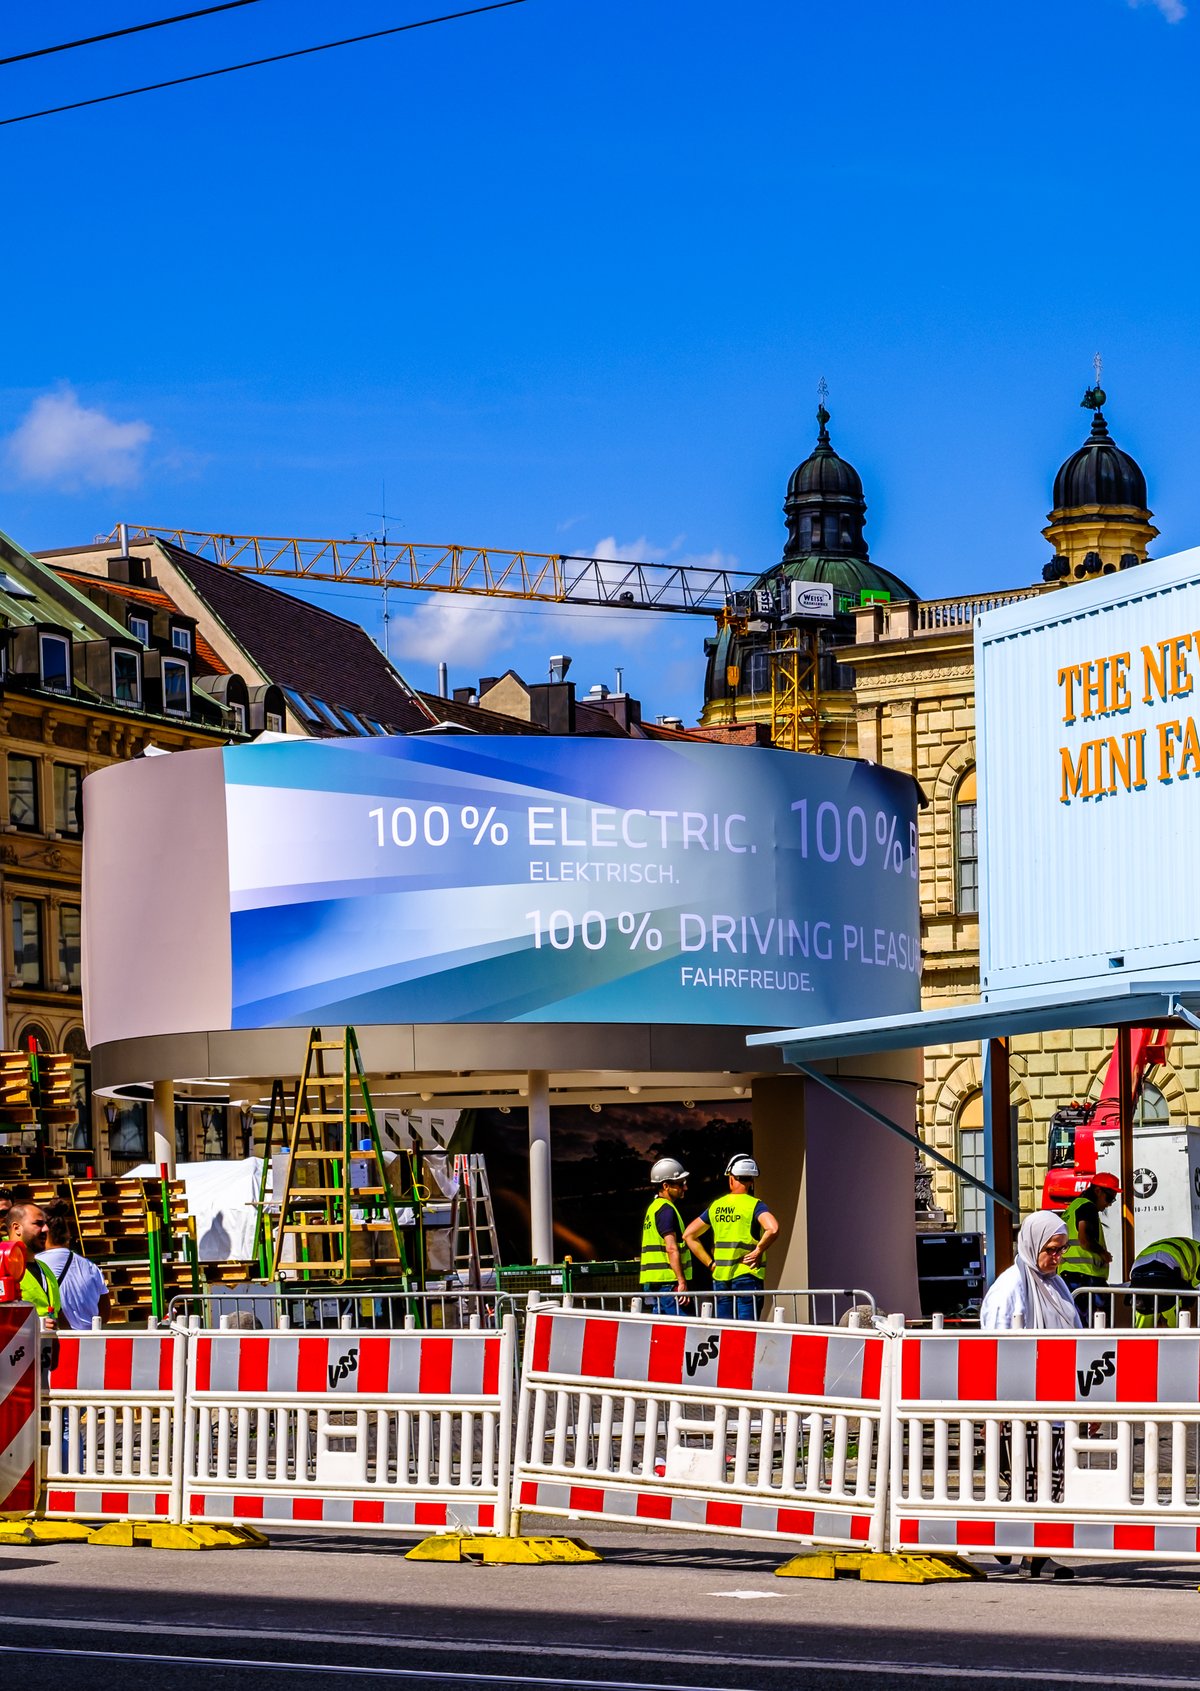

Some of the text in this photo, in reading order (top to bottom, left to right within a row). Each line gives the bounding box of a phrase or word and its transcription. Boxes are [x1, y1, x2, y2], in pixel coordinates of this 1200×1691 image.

[1057, 651, 1132, 727] THE
[1058, 729, 1147, 806] MINI
[527, 806, 757, 854] ELECTRIC.
[529, 861, 680, 884] ELEKTRISCH.
[679, 913, 833, 961] DRIVING
[681, 966, 815, 992] FAHRFREUDE.
[714, 1214, 741, 1223] GROUP
[715, 1206, 736, 1214] BMW
[9, 1346, 25, 1366] VSS
[327, 1348, 358, 1389] VSS
[685, 1334, 720, 1377] VSS
[1077, 1350, 1116, 1397] VSS
